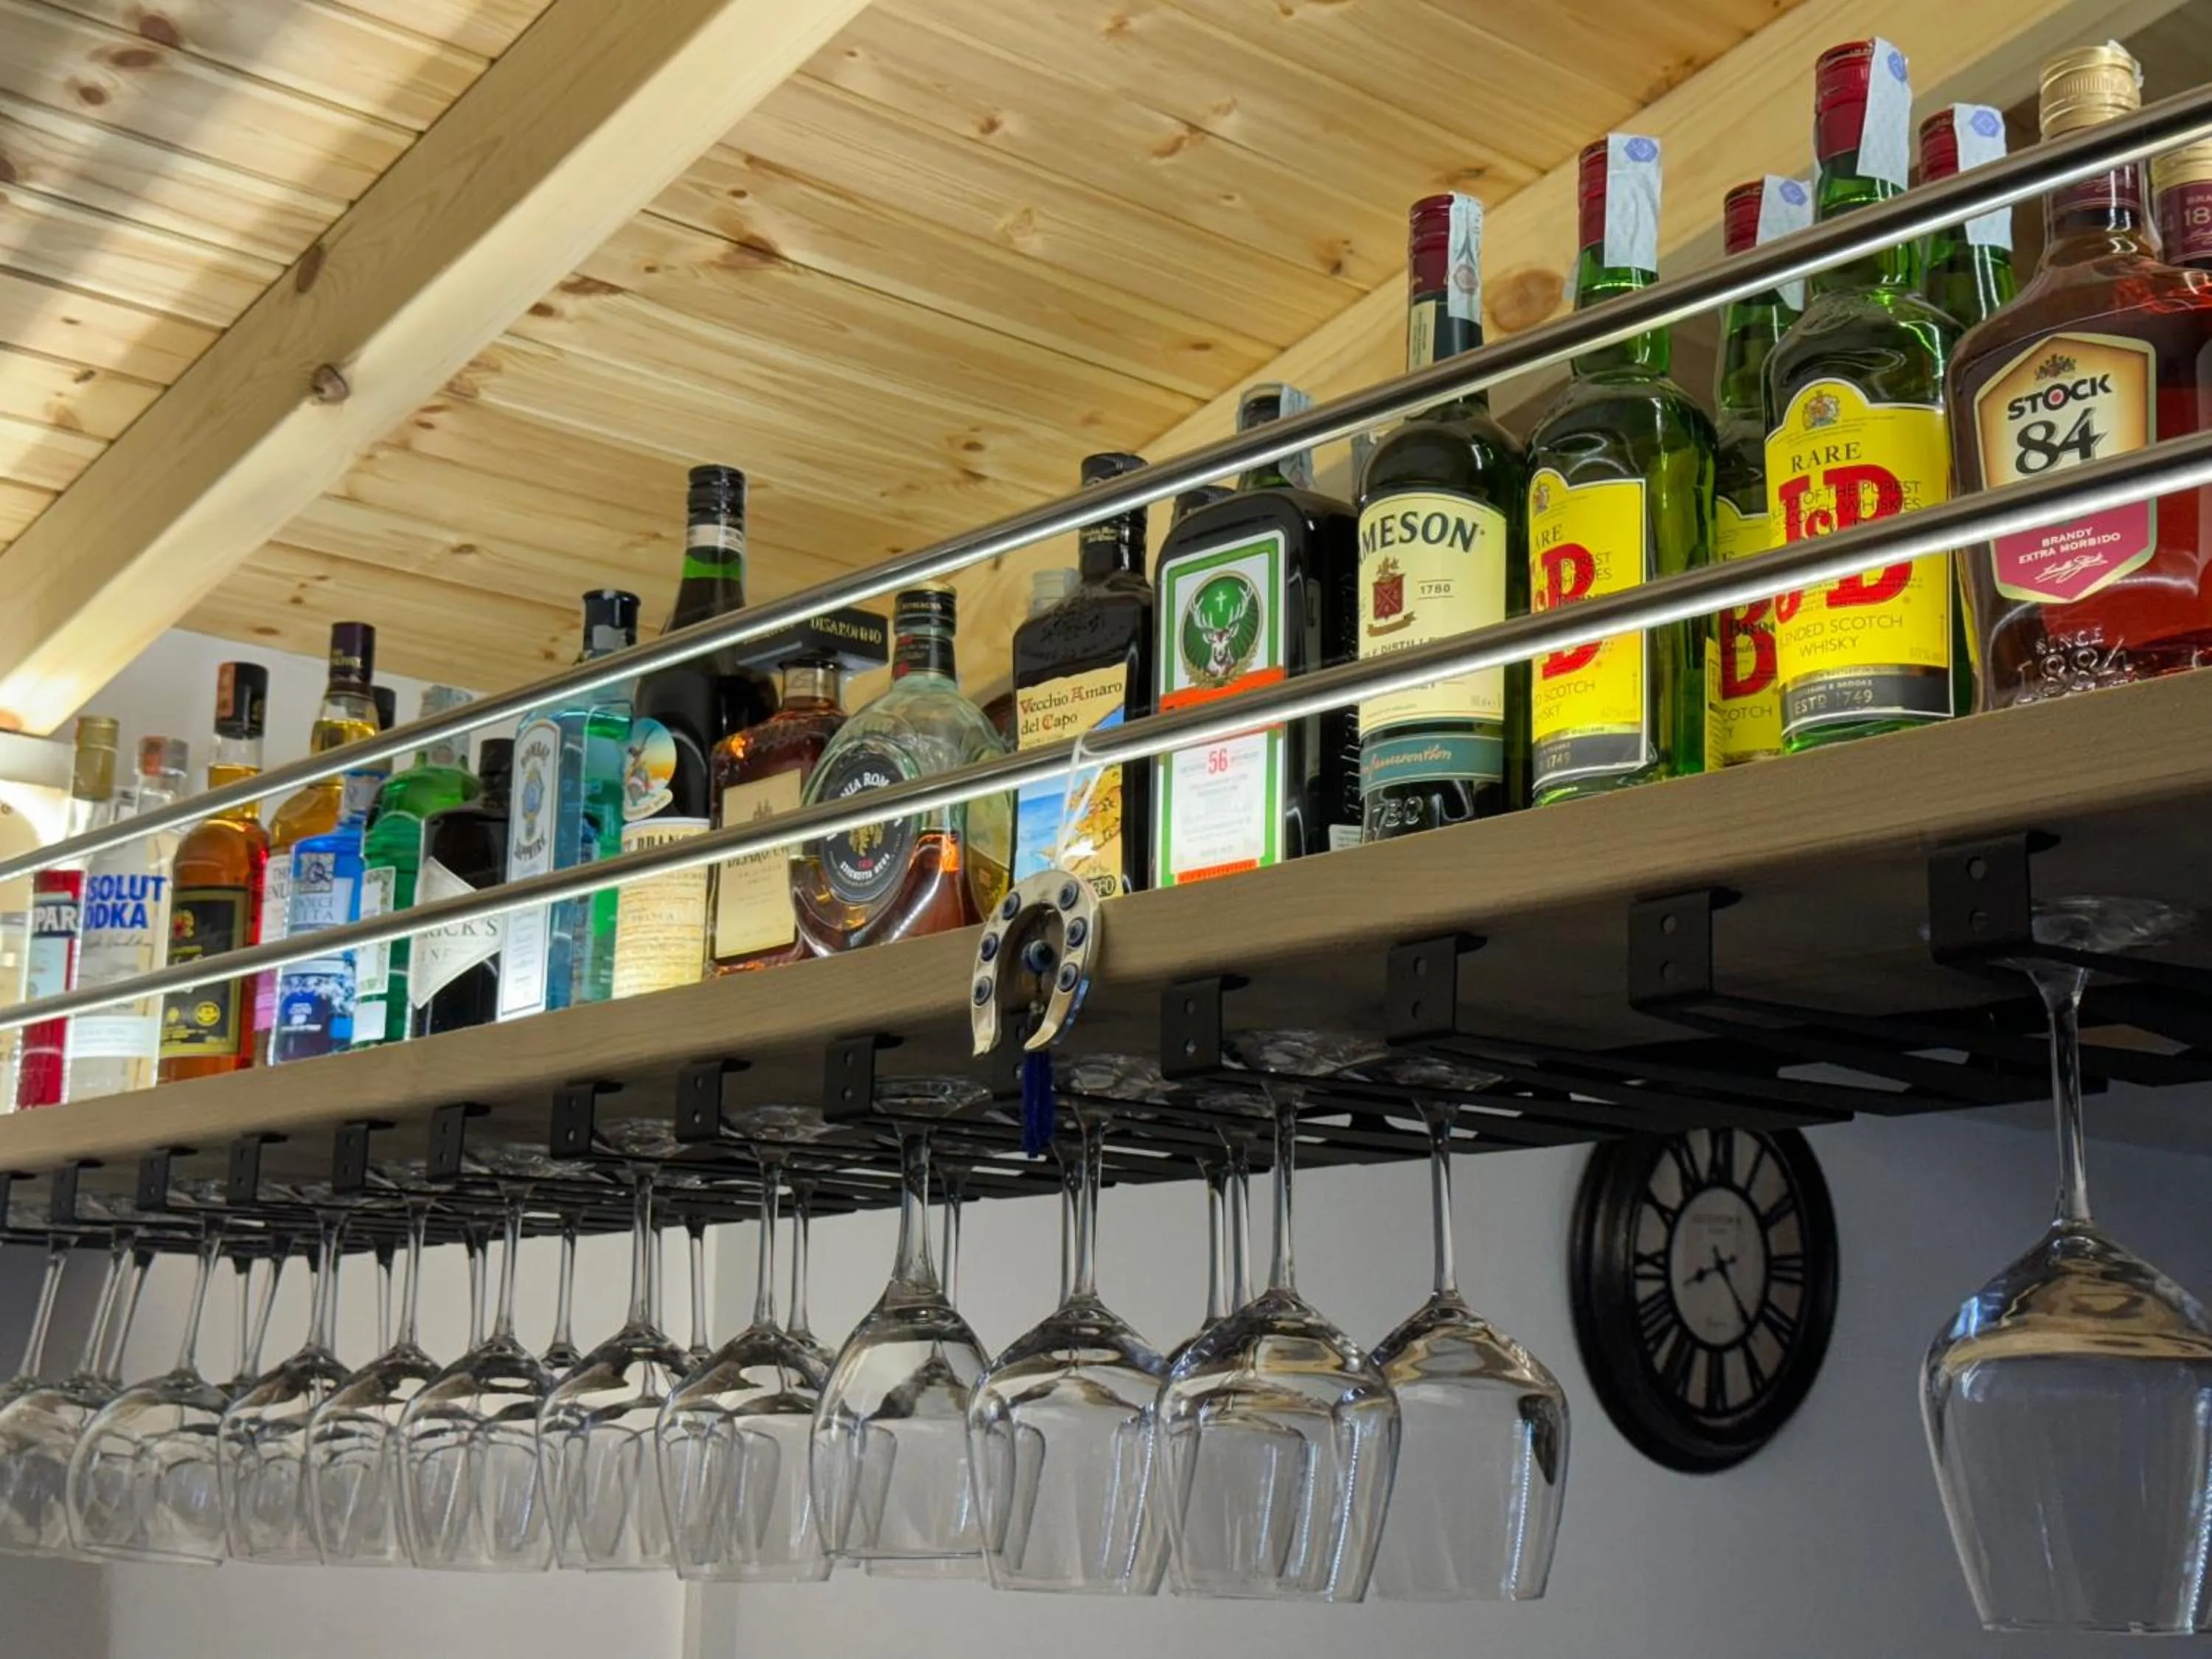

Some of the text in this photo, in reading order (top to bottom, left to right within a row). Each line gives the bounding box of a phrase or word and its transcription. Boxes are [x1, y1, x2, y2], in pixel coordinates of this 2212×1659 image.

[2008, 373, 2112, 421] STOCK
[2015, 406, 2107, 475] 84
[1791, 442, 1863, 473] RARE
[1861, 480, 1921, 495] PUREST
[2018, 532, 2121, 565] EXTRA MORBIDO
[2041, 526, 2093, 548] BRANDY
[1420, 582, 1451, 595] 1780
[1830, 615, 1902, 634] SCOTCH
[1798, 635, 1860, 658] WHISKY
[1019, 681, 1122, 715] Vecchio Amaro
[1020, 712, 1079, 736] del Capo
[1208, 748, 1229, 775] 56
[87, 874, 168, 902] SOLUT
[33, 905, 78, 933] PAR
